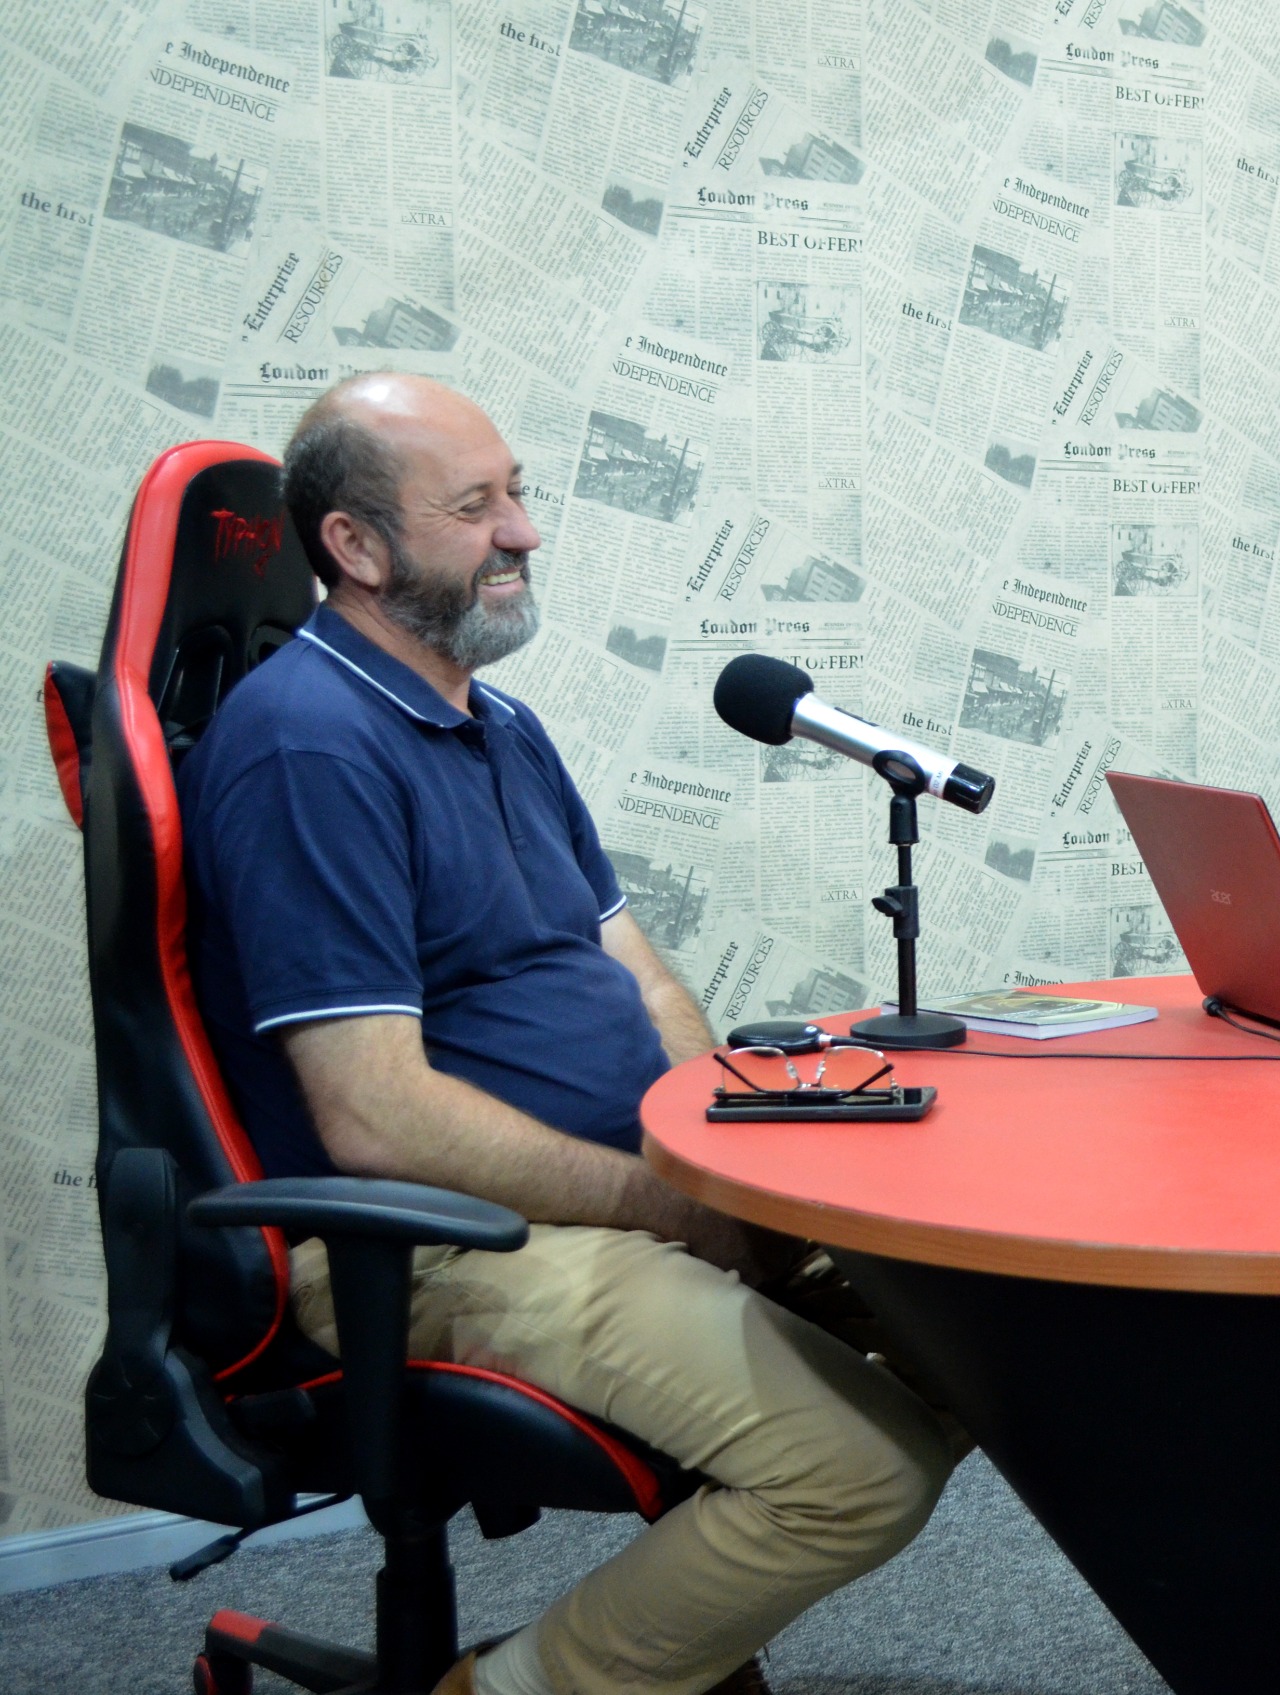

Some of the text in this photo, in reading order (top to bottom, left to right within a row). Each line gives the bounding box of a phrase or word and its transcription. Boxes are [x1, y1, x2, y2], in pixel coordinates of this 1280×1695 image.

[499, 22, 526, 43] the
[180, 41, 290, 93] Independence
[1115, 85, 1150, 103] BEST
[717, 88, 769, 171] RESOURCES
[1236, 157, 1255, 176] the
[20, 191, 51, 215] the
[1014, 176, 1090, 219] Independence
[757, 230, 800, 248] BEST
[284, 251, 343, 343] RESOURCES
[902, 302, 923, 320] the
[636, 335, 728, 377] Independence
[1082, 350, 1124, 426] RESOURCES
[1112, 478, 1149, 495] BEST
[720, 517, 770, 601] RESOURCES
[1232, 537, 1251, 553] the
[1013, 578, 1088, 613] Independence
[903, 712, 924, 729] the
[641, 769, 732, 802] Independence
[1080, 737, 1122, 816] RESOURCES
[1111, 862, 1144, 877] BEST
[702, 940, 739, 1010] nterprise
[726, 936, 774, 1021] RESOURCES
[53, 1170, 84, 1188] the
